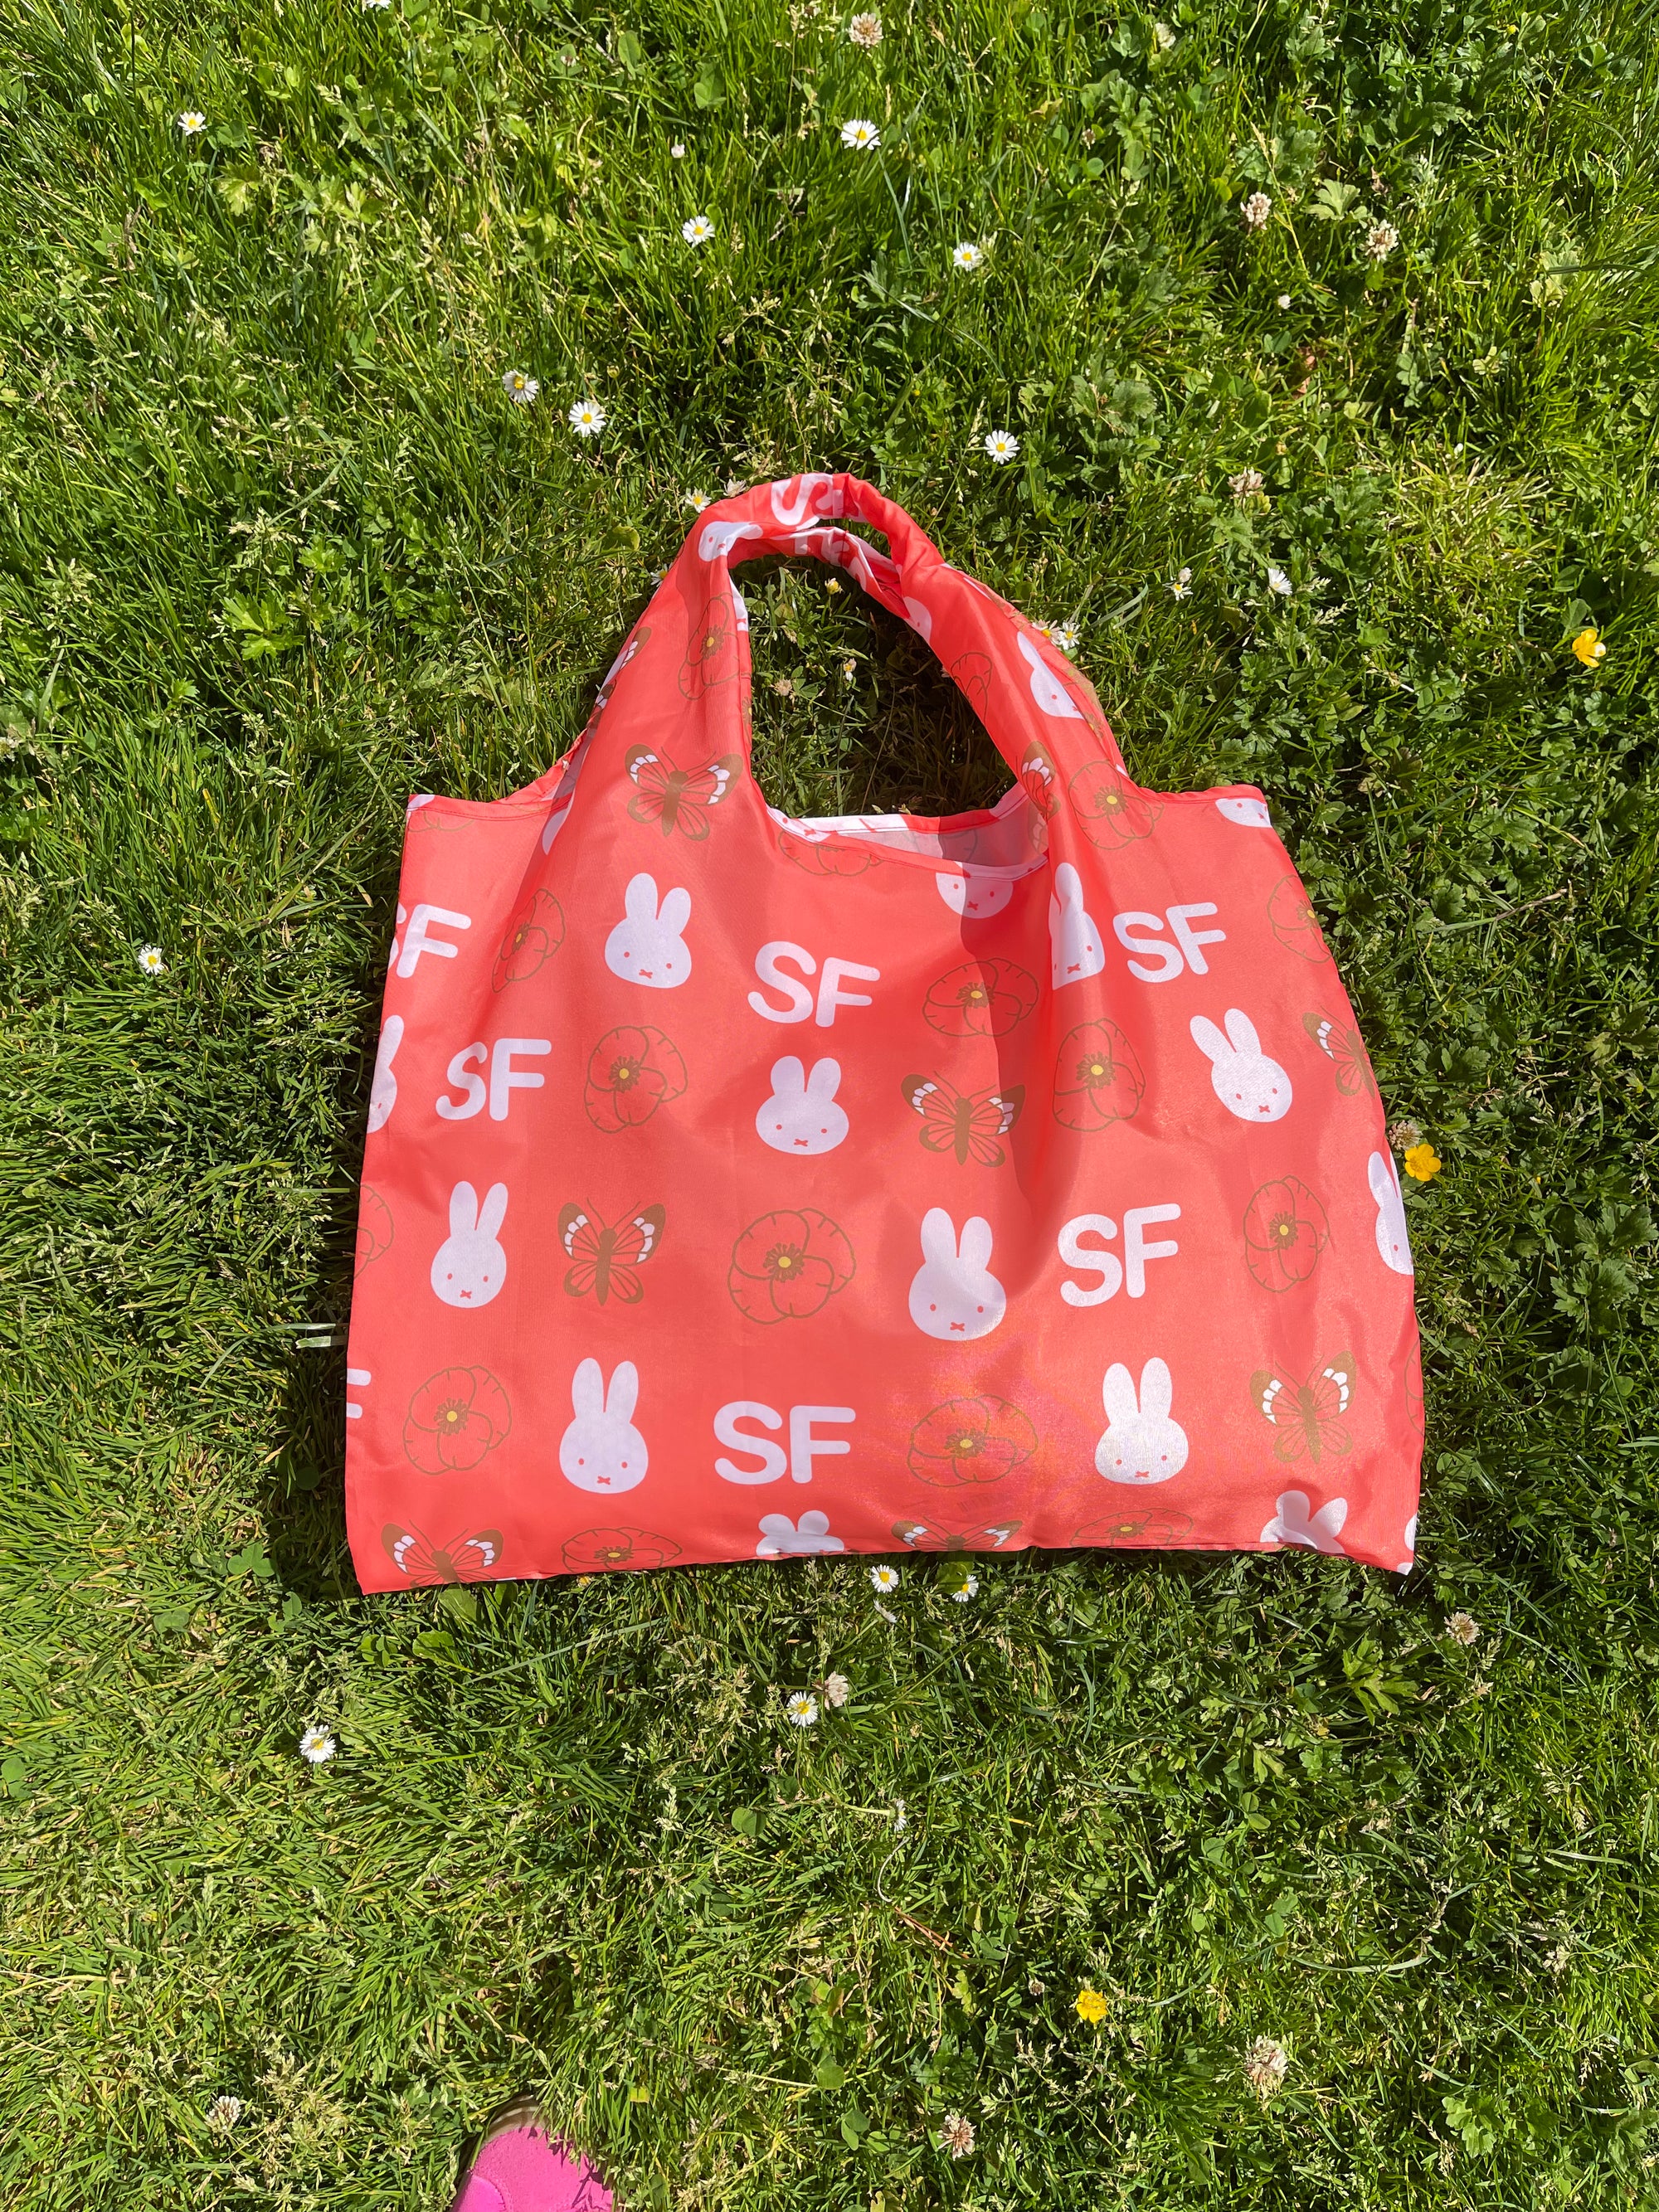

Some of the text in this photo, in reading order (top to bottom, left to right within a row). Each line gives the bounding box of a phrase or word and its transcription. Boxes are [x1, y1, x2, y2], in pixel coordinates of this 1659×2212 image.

[748, 941, 880, 1027] SF
[1113, 902, 1226, 983] SF
[435, 1038, 552, 1121] SF
[1058, 1203, 1181, 1307] SF
[714, 1401, 856, 1485] SF
